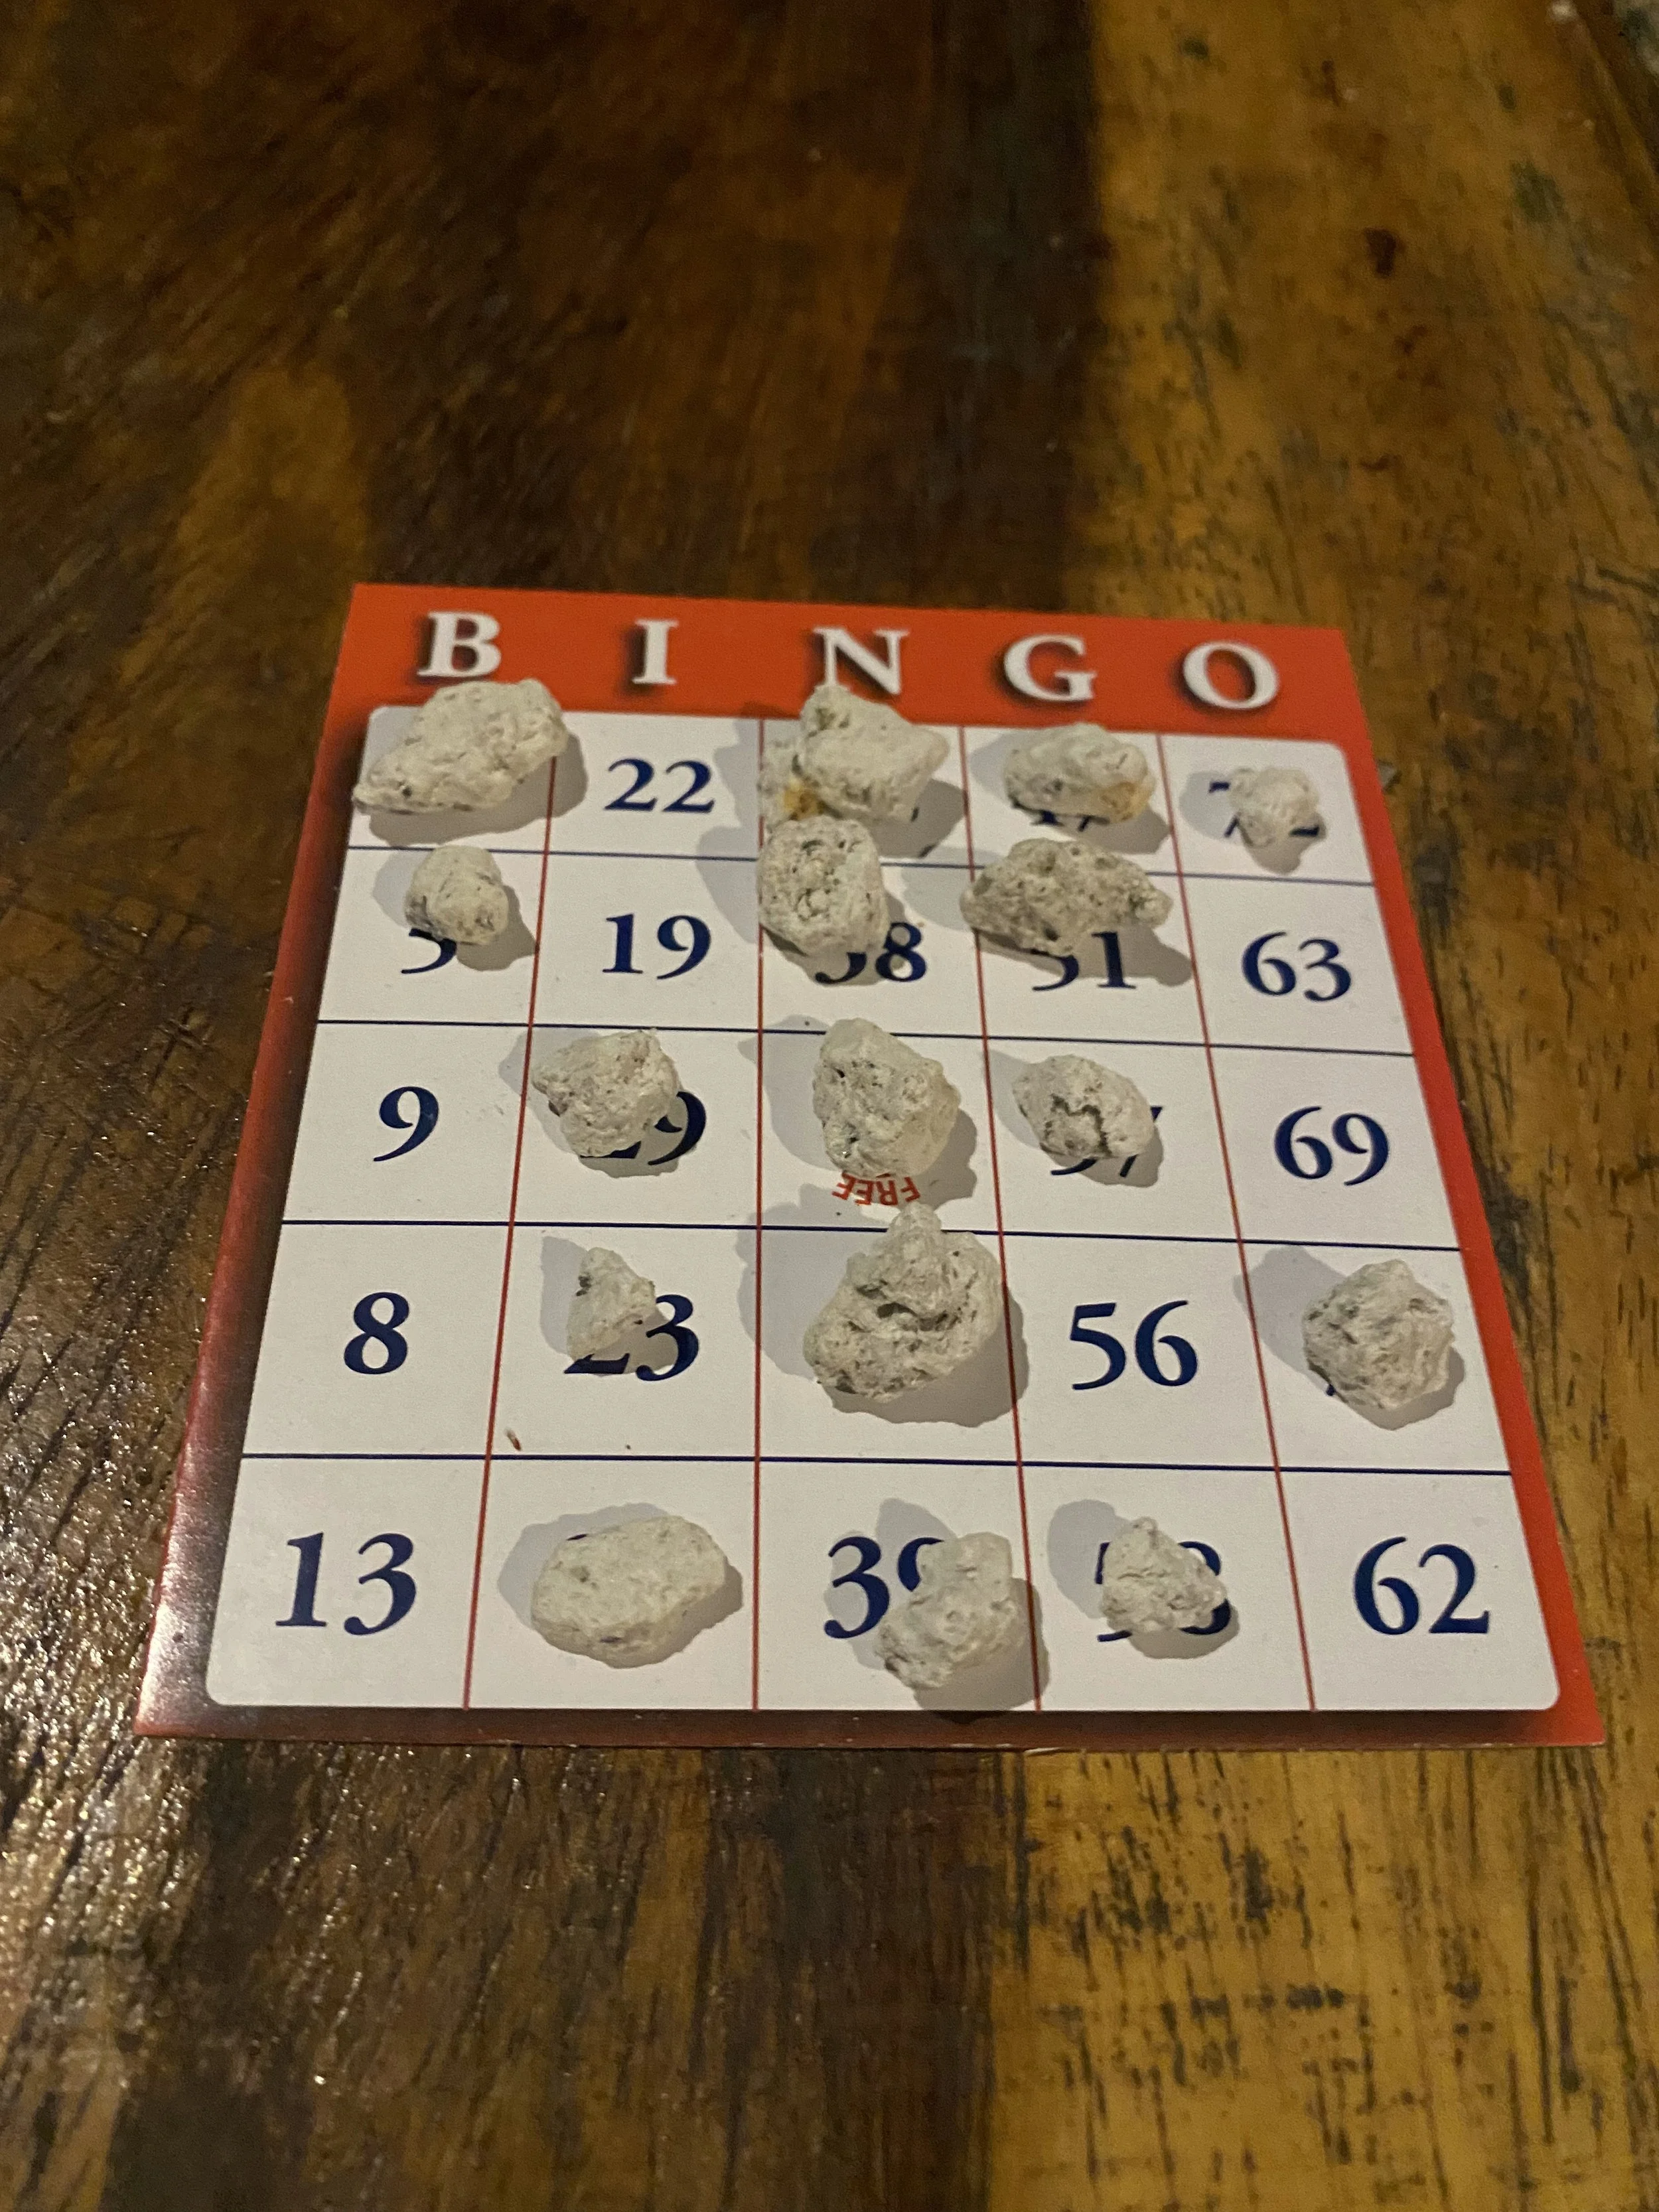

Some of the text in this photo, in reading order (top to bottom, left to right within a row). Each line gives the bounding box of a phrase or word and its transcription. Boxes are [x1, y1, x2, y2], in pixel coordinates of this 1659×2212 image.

[604, 758, 715, 814] 22
[603, 913, 712, 980] 19
[1241, 930, 1353, 1002] 63
[373, 1086, 1391, 1187] 9 9 69
[831, 1172, 921, 1207] FREE
[343, 1291, 1199, 1391] 8 3 56
[274, 1532, 417, 1636] 13
[1352, 1536, 1490, 1636] 62
